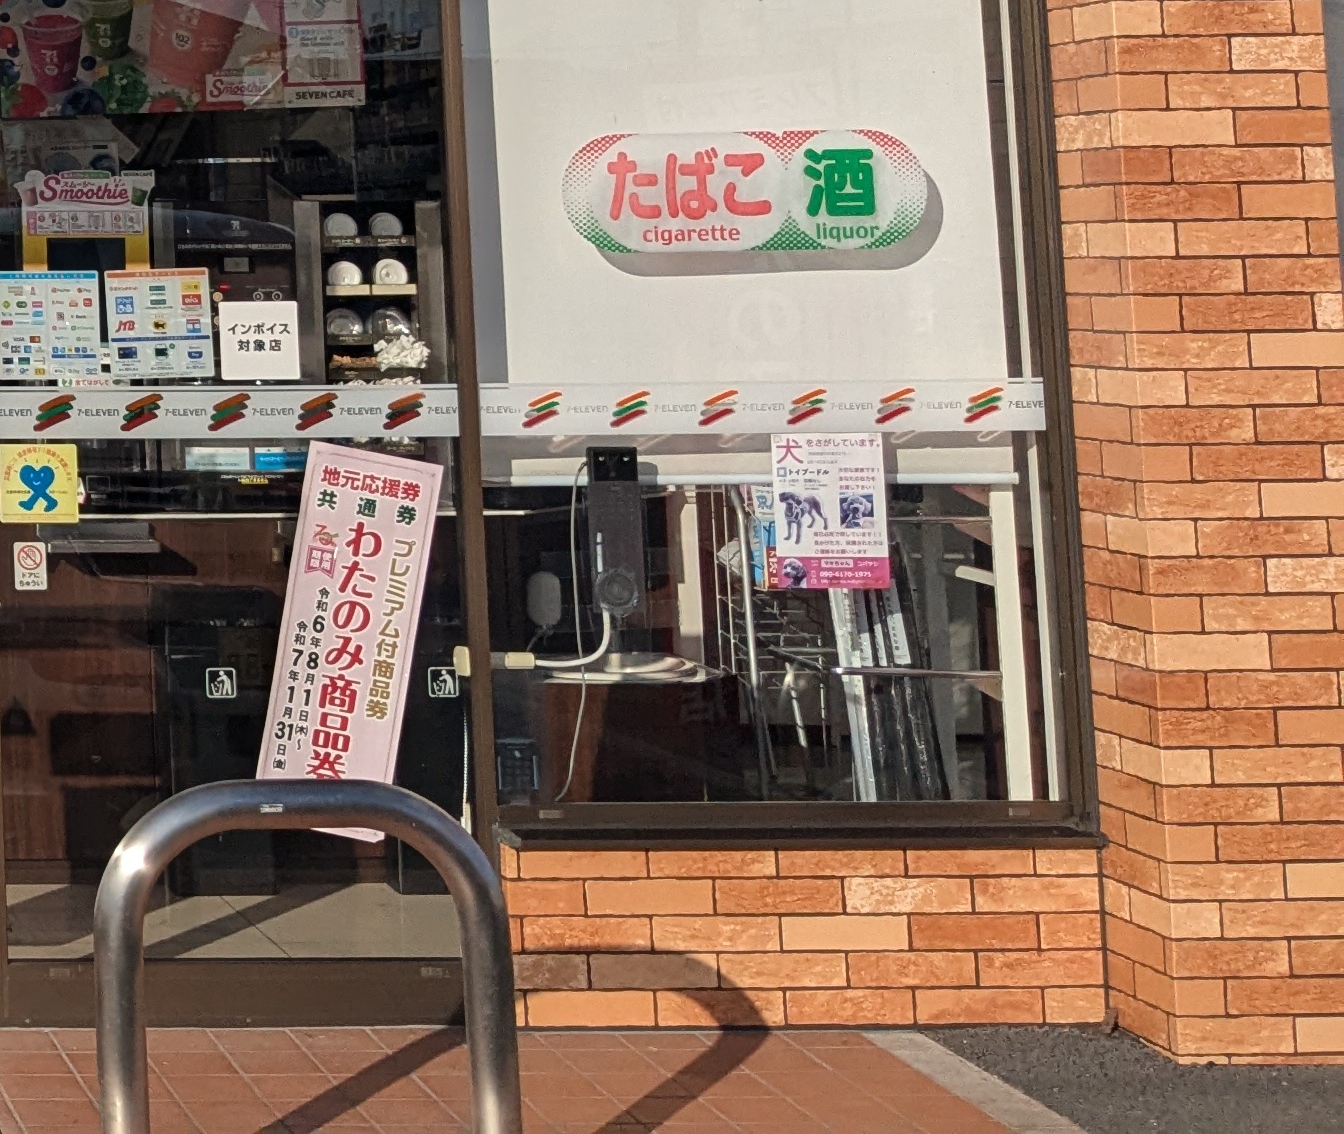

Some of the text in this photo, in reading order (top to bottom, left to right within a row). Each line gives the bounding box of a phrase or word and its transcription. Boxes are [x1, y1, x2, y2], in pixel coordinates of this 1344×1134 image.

[295, 91, 327, 102] SEVEN
[38, 174, 129, 202] Smoothie
[607, 147, 772, 221] たばこ
[803, 148, 876, 217] 酒
[641, 221, 880, 246] cigarette liquor
[227, 322, 291, 336] インボイス
[237, 339, 282, 353] 対象店
[776, 438, 881, 464] 犬 をさがしています。
[321, 465, 421, 502] 地元応援券
[317, 488, 417, 526] 共通券
[365, 538, 417, 721] プレミアム付商品券
